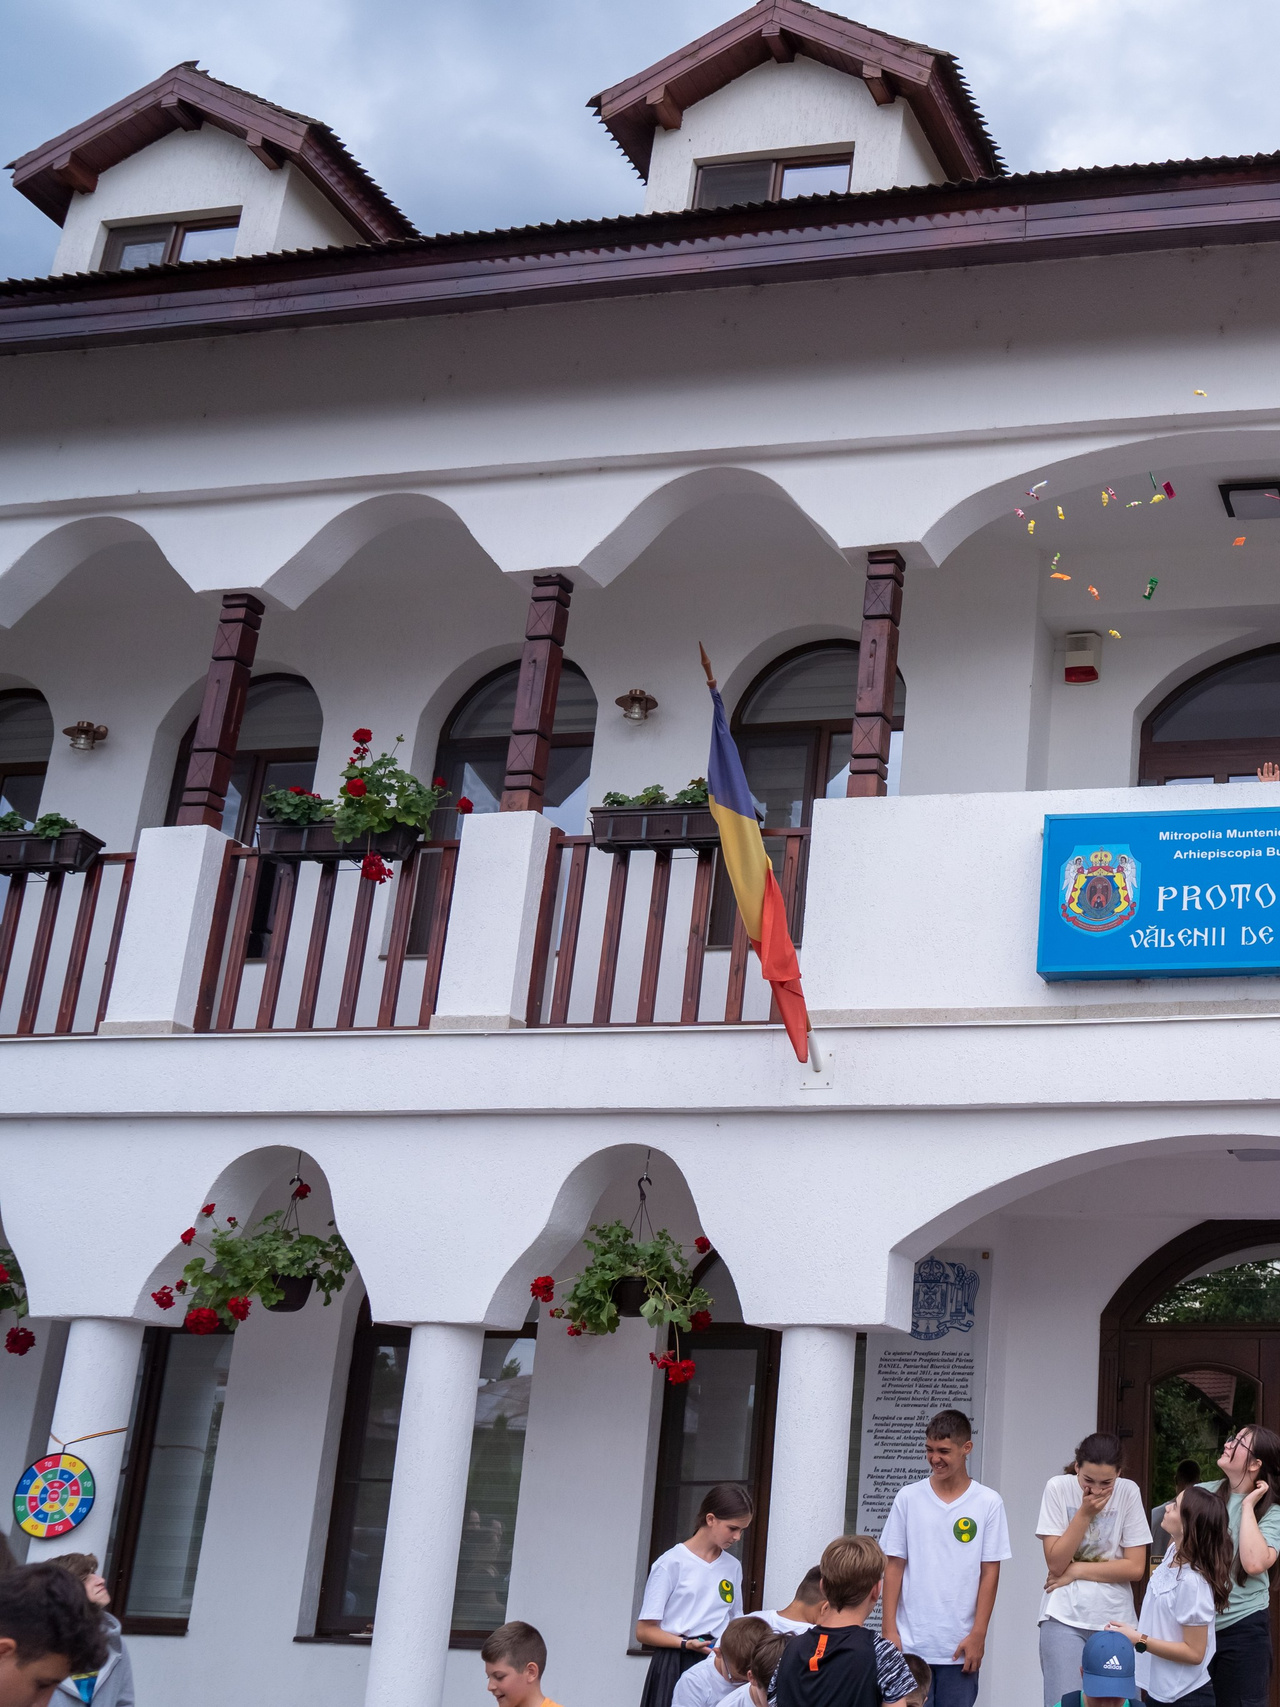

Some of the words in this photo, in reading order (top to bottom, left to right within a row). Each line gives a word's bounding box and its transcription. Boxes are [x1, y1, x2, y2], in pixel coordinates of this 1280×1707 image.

[1159, 827, 1223, 842] Mitropolia
[1173, 846, 1262, 861] Arhiepiscopia
[1129, 925, 1225, 948] VĂLENII
[1241, 925, 1274, 945] DE
